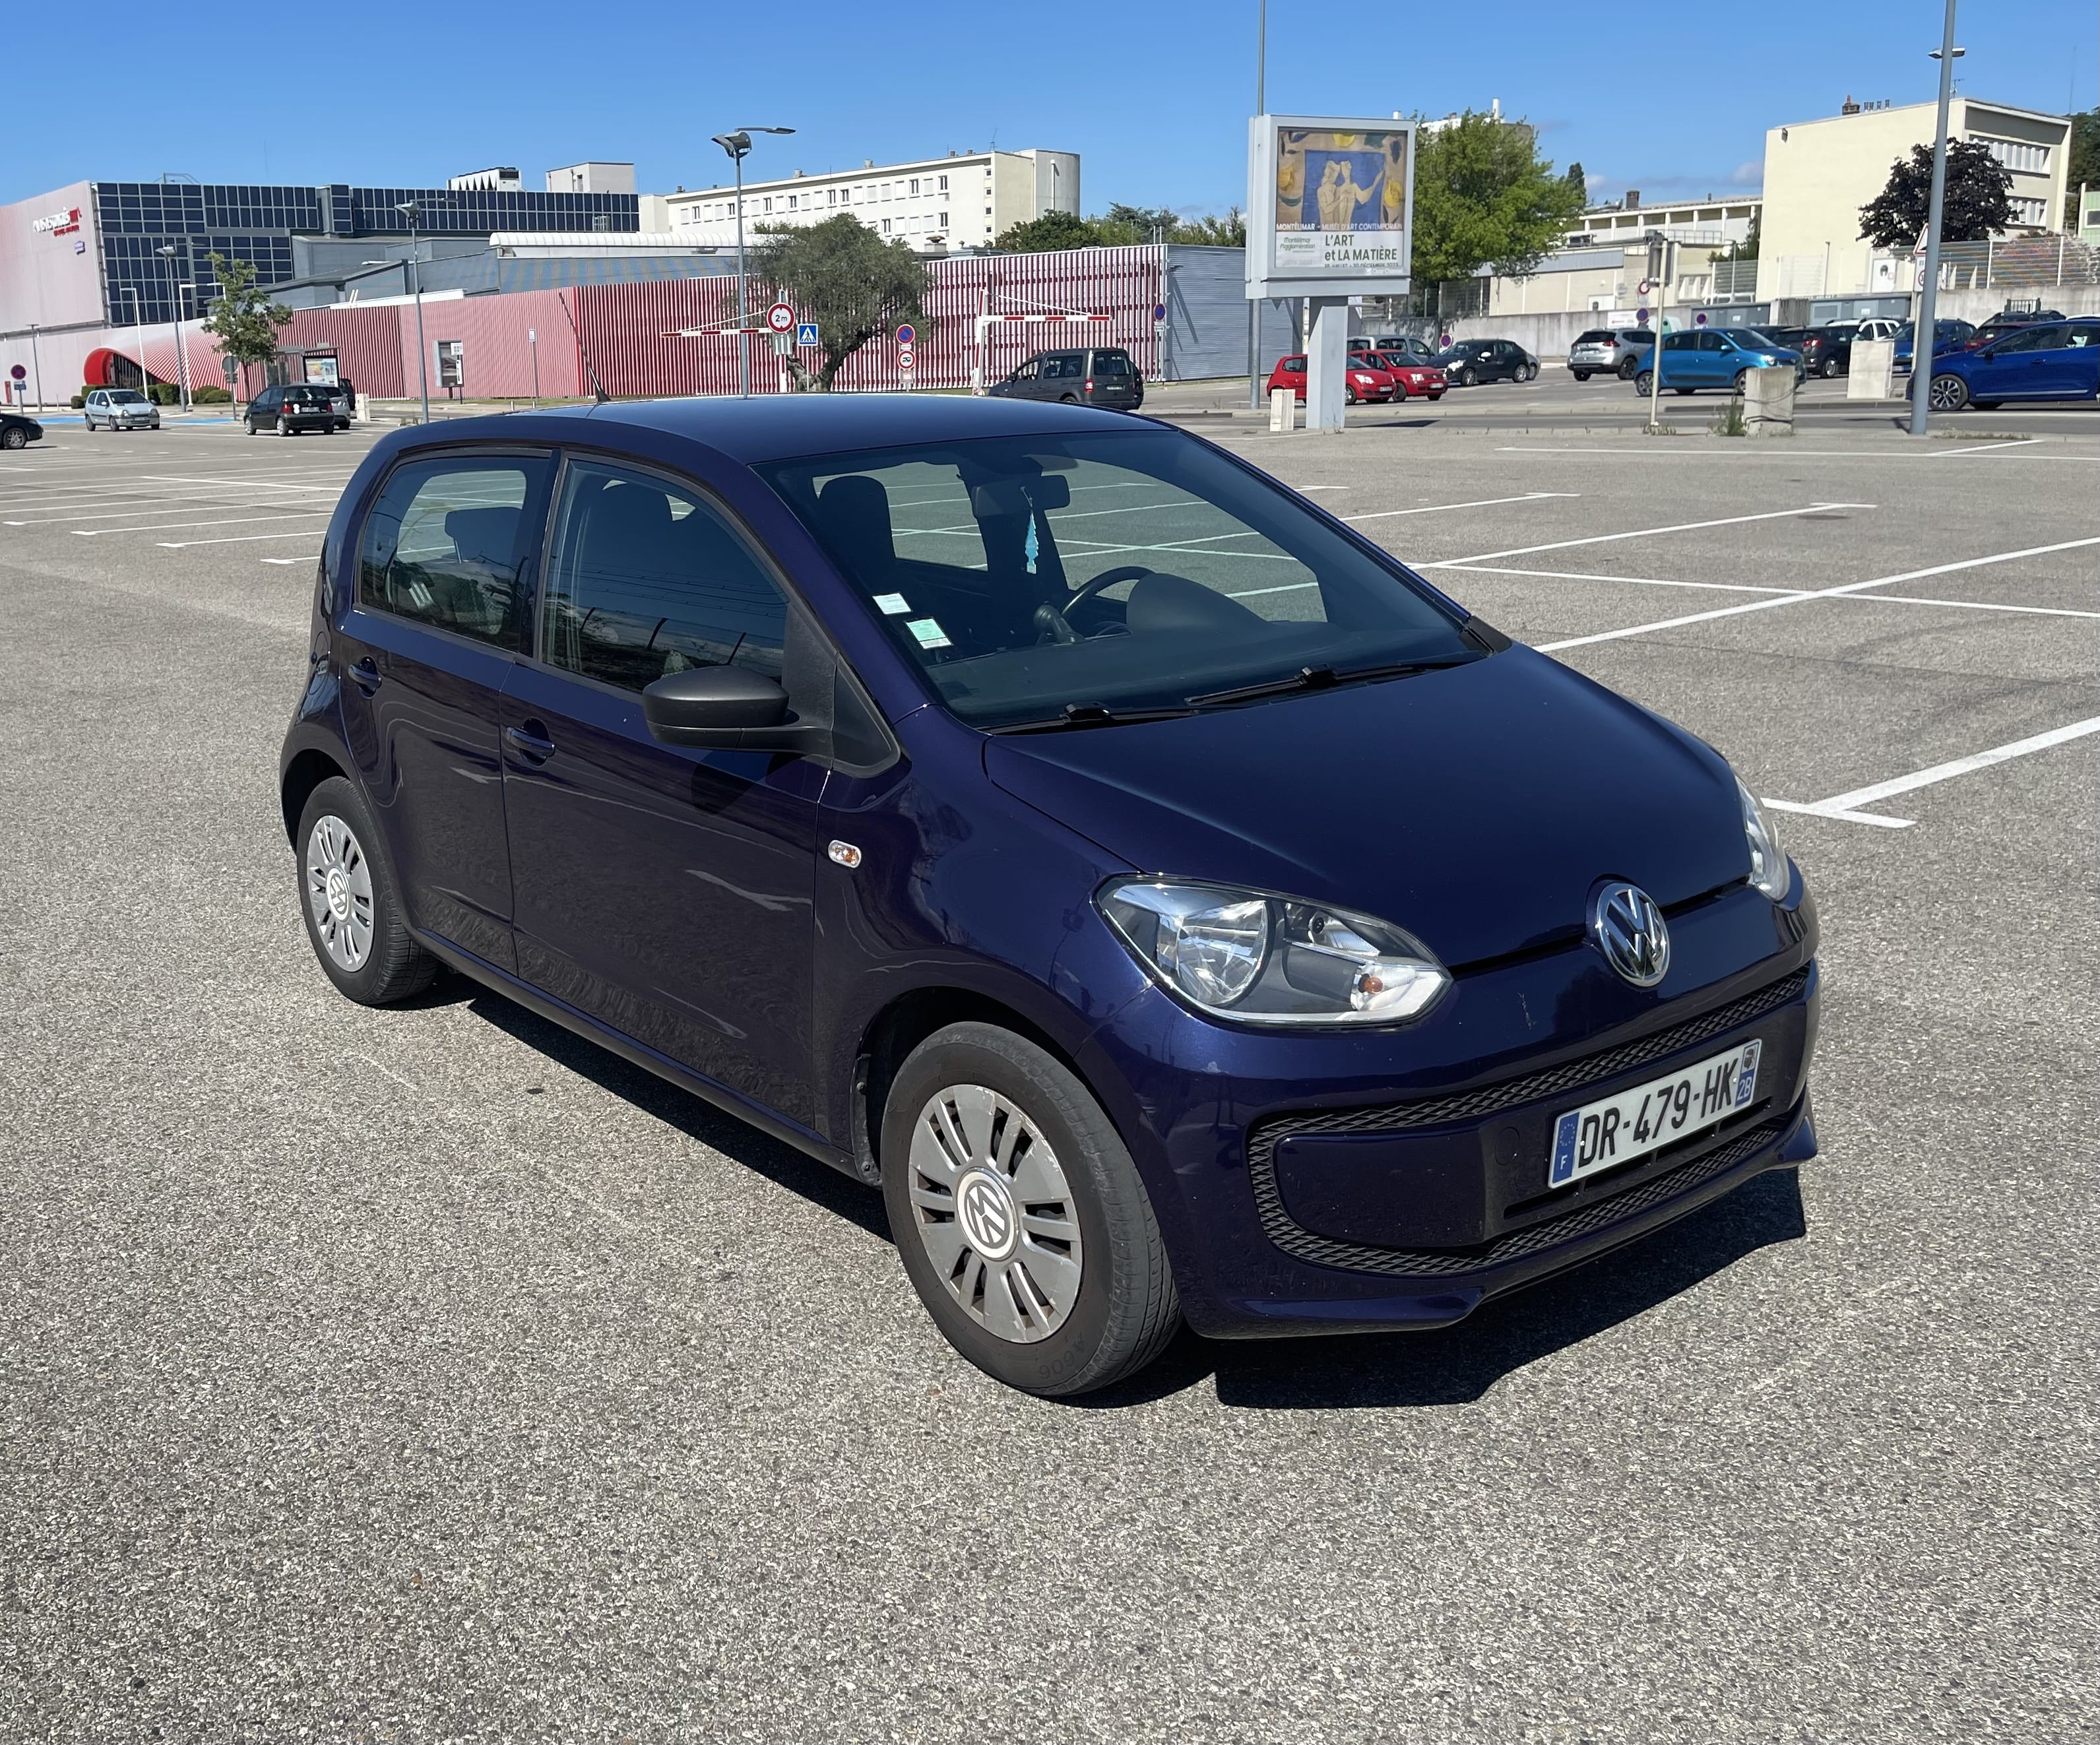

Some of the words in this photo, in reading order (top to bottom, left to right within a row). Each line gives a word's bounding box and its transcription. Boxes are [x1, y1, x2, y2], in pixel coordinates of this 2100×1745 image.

[1276, 222, 1316, 230] MONTÉLIMAR
[1325, 234, 1354, 246] L'ART
[1325, 250, 1335, 261] et
[1338, 249, 1350, 261] LA
[1352, 245, 1397, 261] MATIÈRE
[1736, 1075, 1752, 1101] 2B
[1578, 1057, 1738, 1168] DR-479-HK
[1560, 1155, 1568, 1170] F
